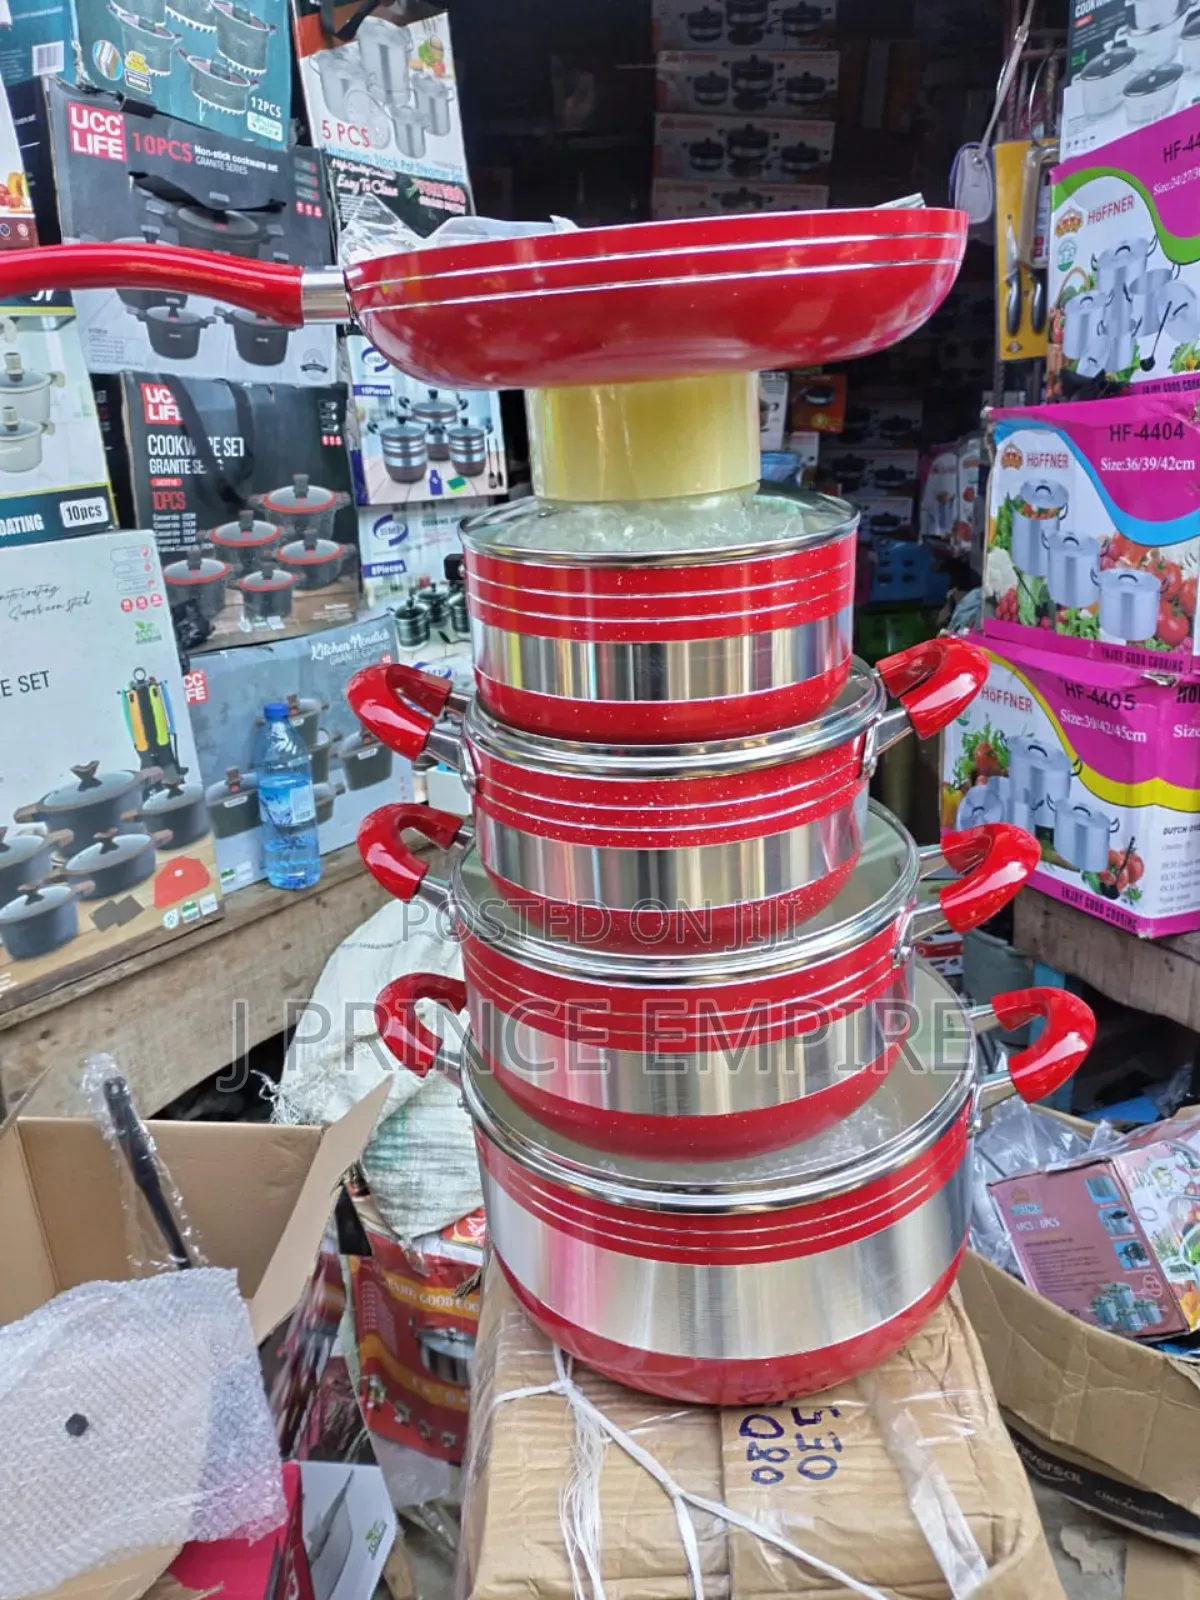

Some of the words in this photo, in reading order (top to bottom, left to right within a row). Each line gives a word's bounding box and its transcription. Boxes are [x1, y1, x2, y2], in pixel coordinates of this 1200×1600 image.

[250, 96, 283, 118] 12PCS
[71, 107, 123, 136] UCC
[321, 119, 332, 140] 5
[336, 122, 372, 148] PCS
[72, 131, 123, 160] LIFE
[131, 132, 194, 163] 10PCS
[1108, 420, 1185, 444] HF-4404
[149, 459, 191, 475] GRANITE
[1100, 456, 1196, 473] Size:36/39/42cm
[65, 505, 103, 521] 10pcs
[152, 491, 187, 511] 10PCS
[17, 670, 50, 694] SET
[1063, 680, 1137, 711] HF-4405
